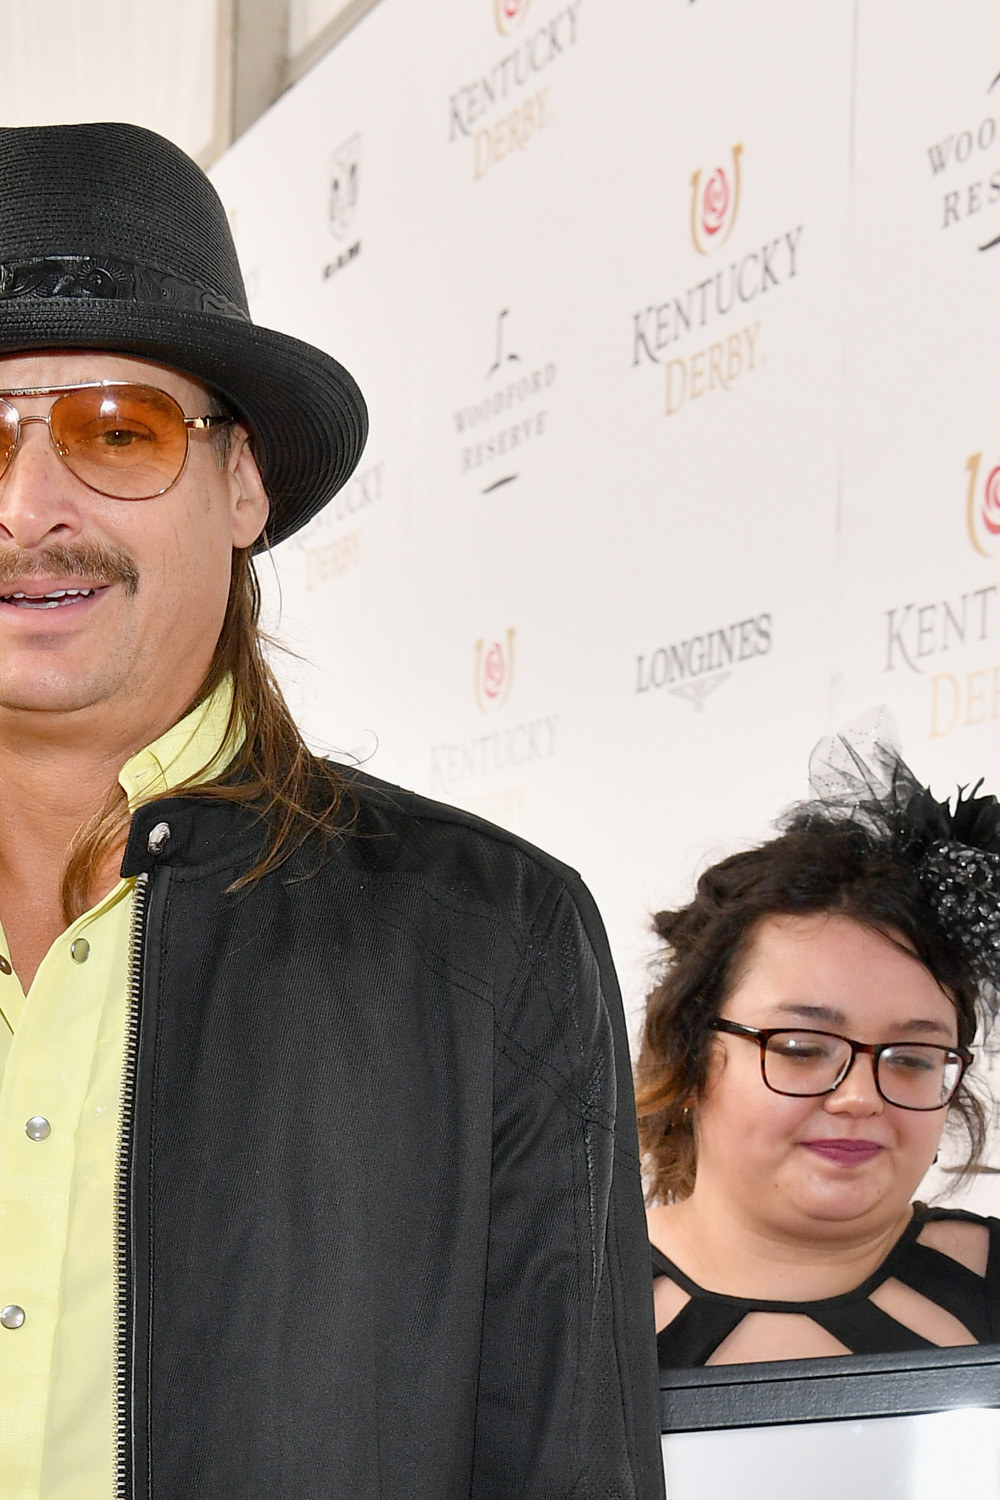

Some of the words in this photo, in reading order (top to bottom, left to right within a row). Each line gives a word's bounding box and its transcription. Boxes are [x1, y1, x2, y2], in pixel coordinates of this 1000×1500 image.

[448, 0, 582, 144] KENTUCKY
[632, 225, 805, 369] KENTUCKY
[452, 360, 557, 434] WOODFORD
[460, 409, 548, 475] RESERVE
[635, 613, 773, 694] LONGINES
[428, 713, 561, 796] KENTUCKY
